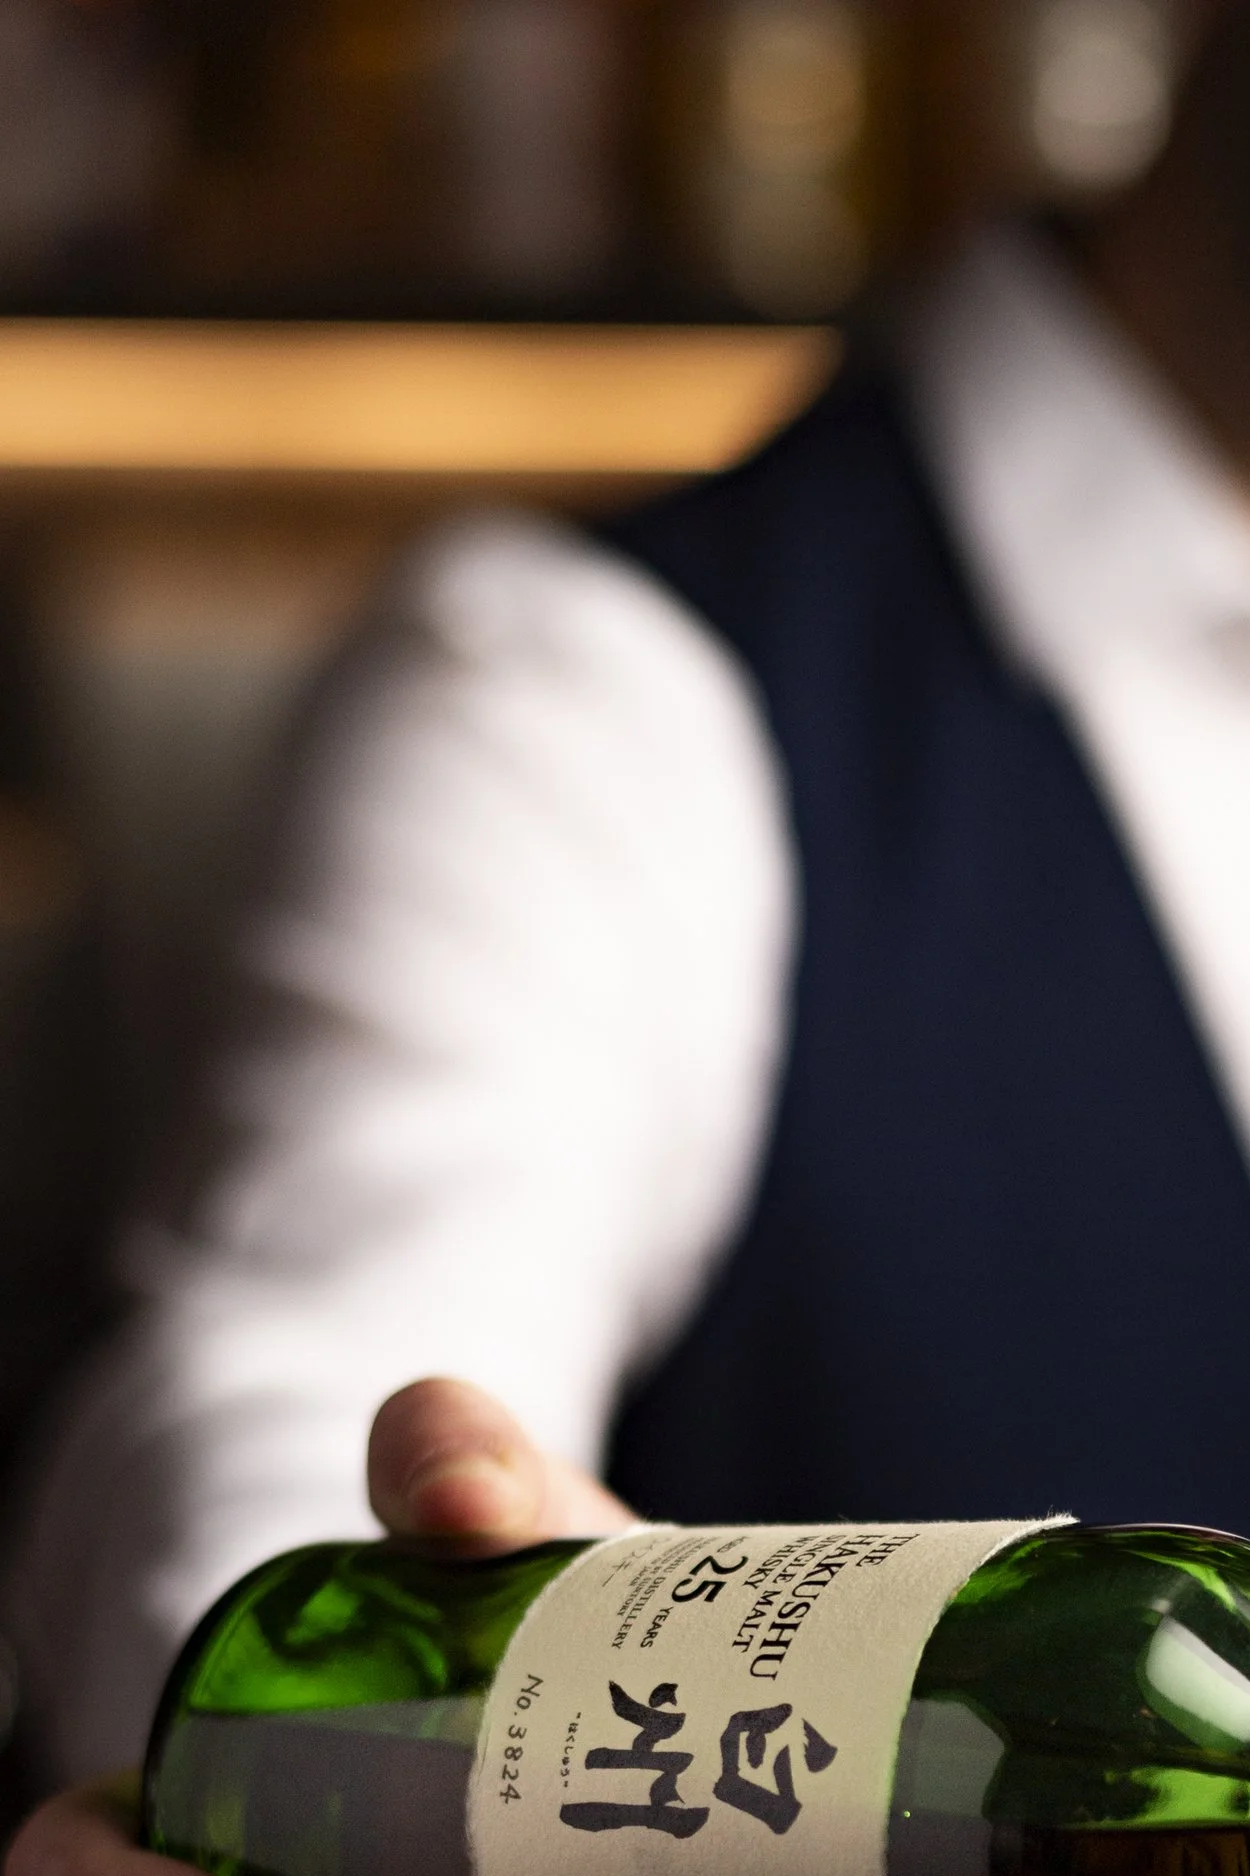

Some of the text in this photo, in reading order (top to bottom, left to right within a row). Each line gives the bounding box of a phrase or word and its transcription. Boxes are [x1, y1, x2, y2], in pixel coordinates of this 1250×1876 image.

[671, 1555, 749, 1603] 25
[742, 1535, 820, 1590] WHISKY
[855, 1533, 920, 1567] THE
[611, 1576, 667, 1650] DISTILLERY
[639, 1606, 674, 1649] YEARS
[731, 1534, 848, 1653] SINGLE MALT
[749, 1534, 885, 1681] HAKUSHU
[499, 1674, 544, 1804] No. 3824
[559, 1680, 839, 1839] 白州
